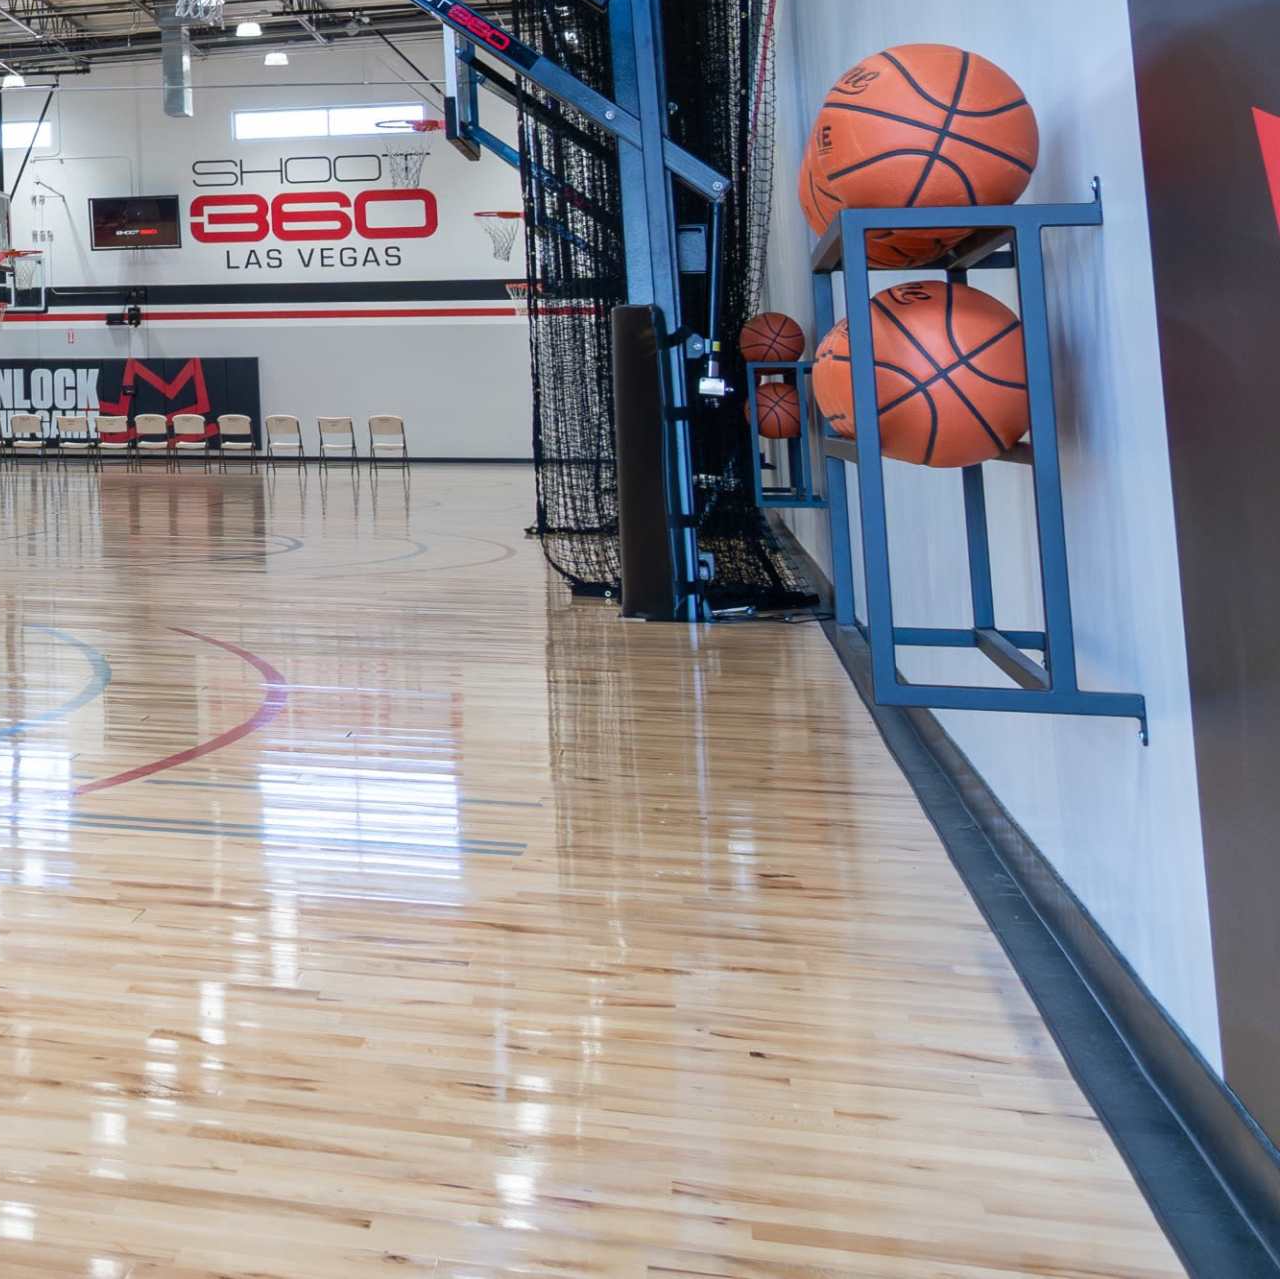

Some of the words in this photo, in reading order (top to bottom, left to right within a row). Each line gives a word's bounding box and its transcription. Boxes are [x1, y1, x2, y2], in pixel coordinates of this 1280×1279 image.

[192, 153, 432, 187] SHOOT
[190, 188, 439, 243] 360
[226, 248, 283, 269] LAS
[297, 246, 403, 268] VEGAS
